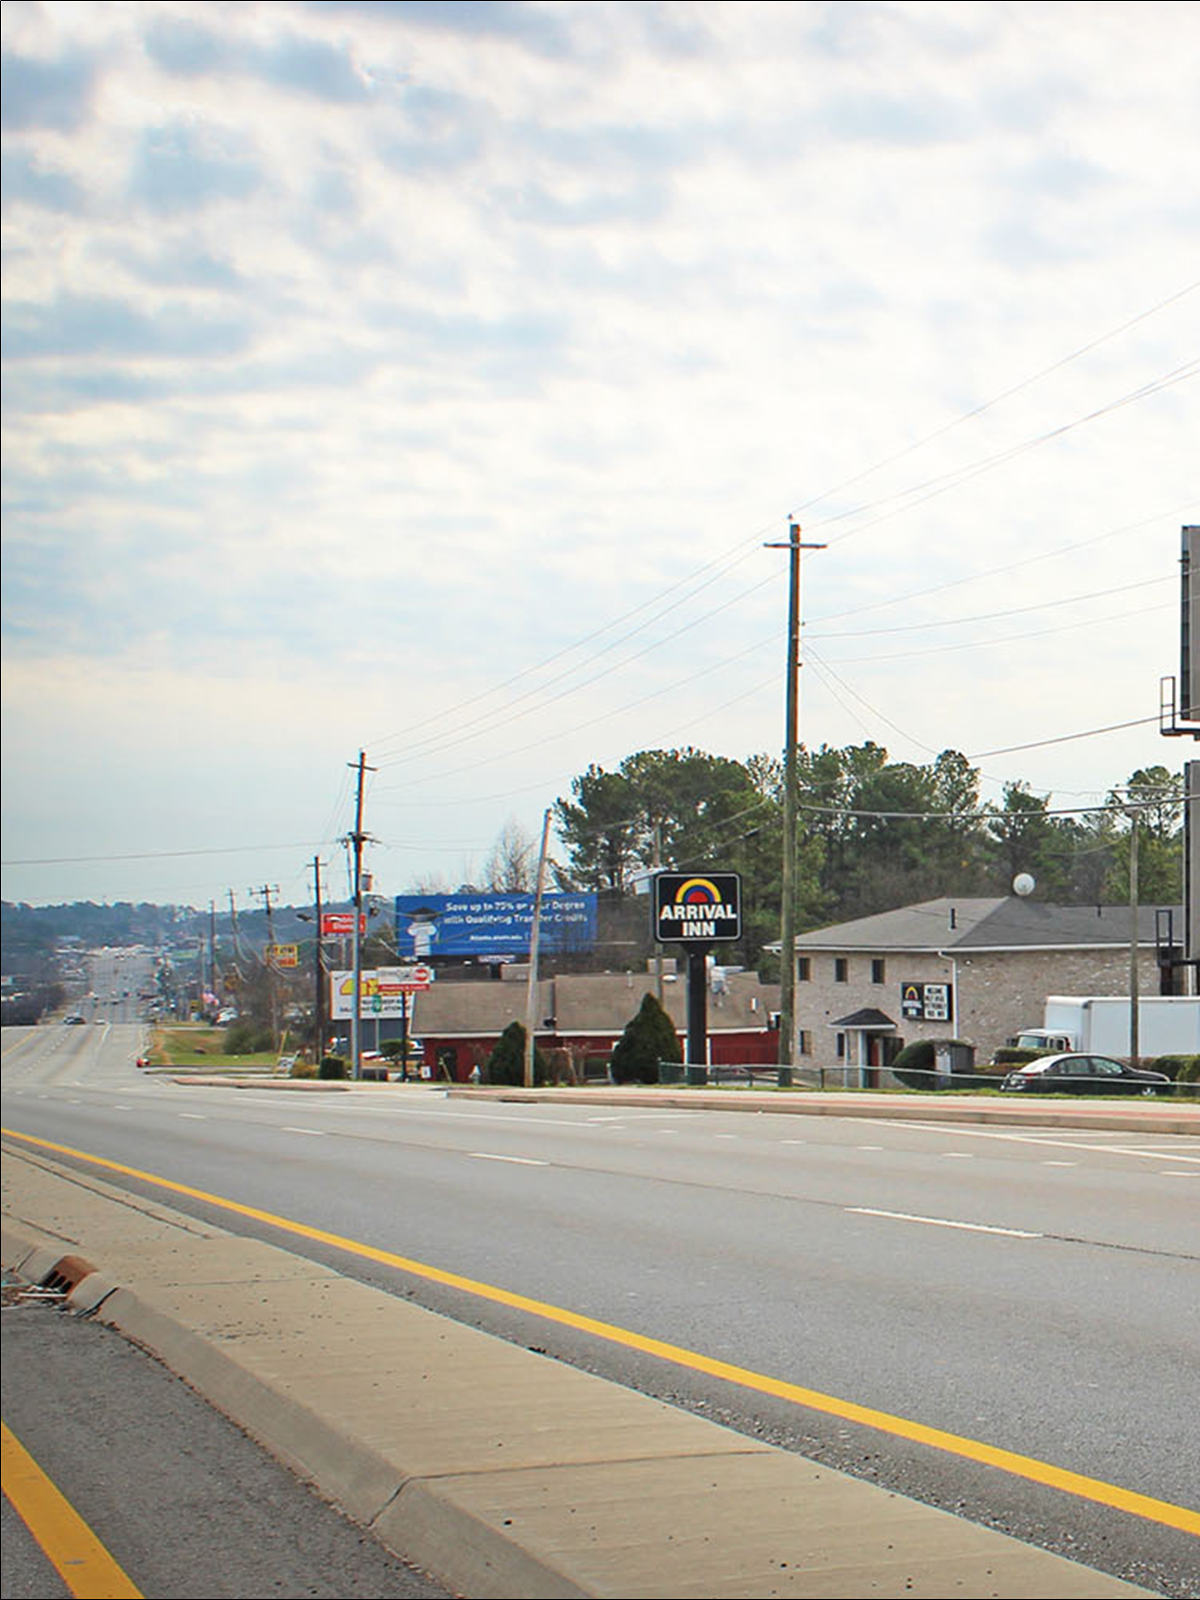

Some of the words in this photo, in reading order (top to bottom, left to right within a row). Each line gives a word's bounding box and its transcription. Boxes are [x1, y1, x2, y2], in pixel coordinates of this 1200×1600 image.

[446, 901, 468, 911] Save
[470, 903, 481, 912] up
[484, 902, 493, 910] to
[530, 902, 550, 911] yur
[552, 901, 585, 911] Degree
[660, 904, 738, 920] ARRIVAL
[465, 914, 512, 924] Qualifying
[682, 921, 716, 936] INN
